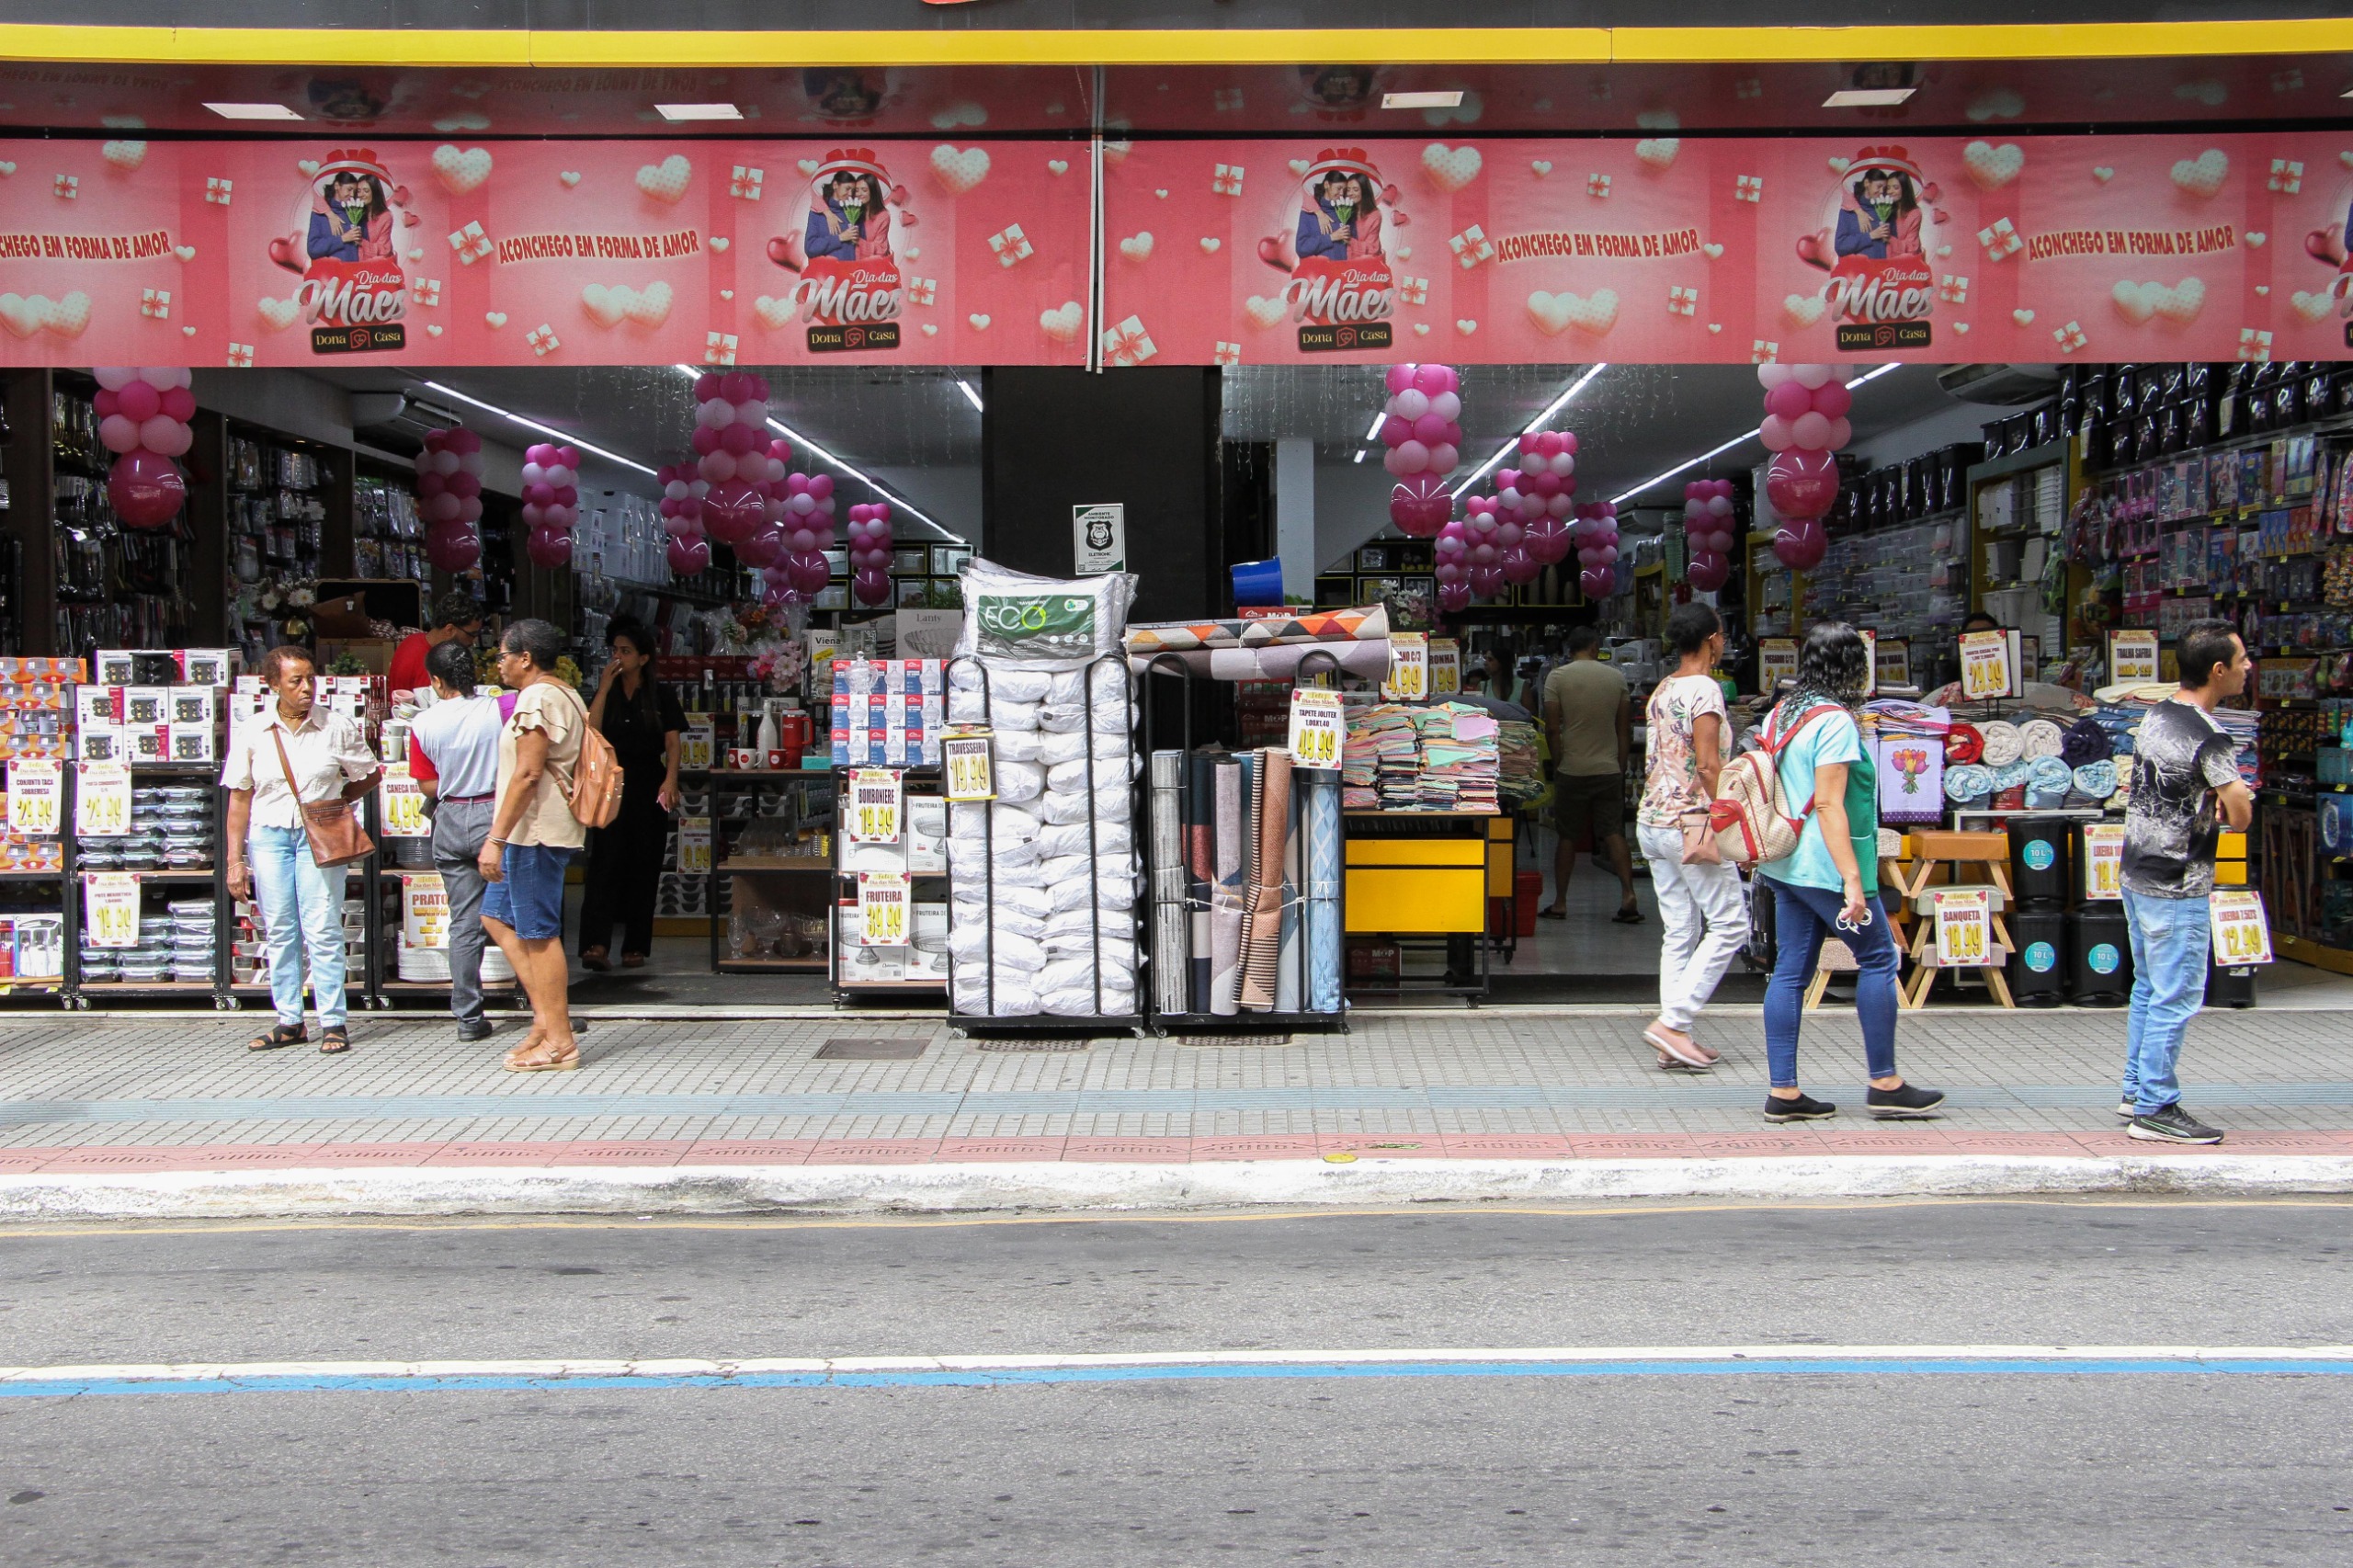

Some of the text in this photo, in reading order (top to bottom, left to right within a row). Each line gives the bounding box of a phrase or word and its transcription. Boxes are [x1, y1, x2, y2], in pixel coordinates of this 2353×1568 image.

[42, 235, 64, 257] EM
[64, 236, 112, 259] FORMA
[112, 237, 131, 258] DE
[133, 232, 171, 257] AMOR
[499, 230, 699, 264] ACONCHEGO EM FORMA DE AMOR
[1498, 228, 1699, 263] ACONCHEGO EM FORMA DE AMOR
[2029, 224, 2234, 261] ACONCHEGO EM FORMA DE AMOR
[355, 270, 402, 284] Dia das
[851, 269, 898, 283] Dia das
[1342, 268, 1390, 283] Dia das
[1881, 267, 1929, 281] Dia das
[297, 276, 407, 326] Mães
[793, 275, 904, 325] Mães
[1285, 274, 1396, 324] Mães
[1823, 273, 1934, 324] Mães
[316, 331, 401, 345] Dona Casa
[812, 330, 895, 344] Dona Casa
[1302, 330, 1387, 344] Dona Casa
[1841, 328, 1927, 342] Dona Casa
[985, 606, 1046, 630] ECO
[815, 637, 841, 645] Viena
[1430, 653, 1455, 665] RONHA
[949, 742, 986, 755] TRAVESSEIRO
[387, 784, 409, 793] CANECA
[858, 789, 894, 804] BOMBONIERE
[412, 894, 449, 905] PRATO
[866, 891, 903, 903] FRUTEIRA
[1943, 910, 1981, 922] BANQUETA
